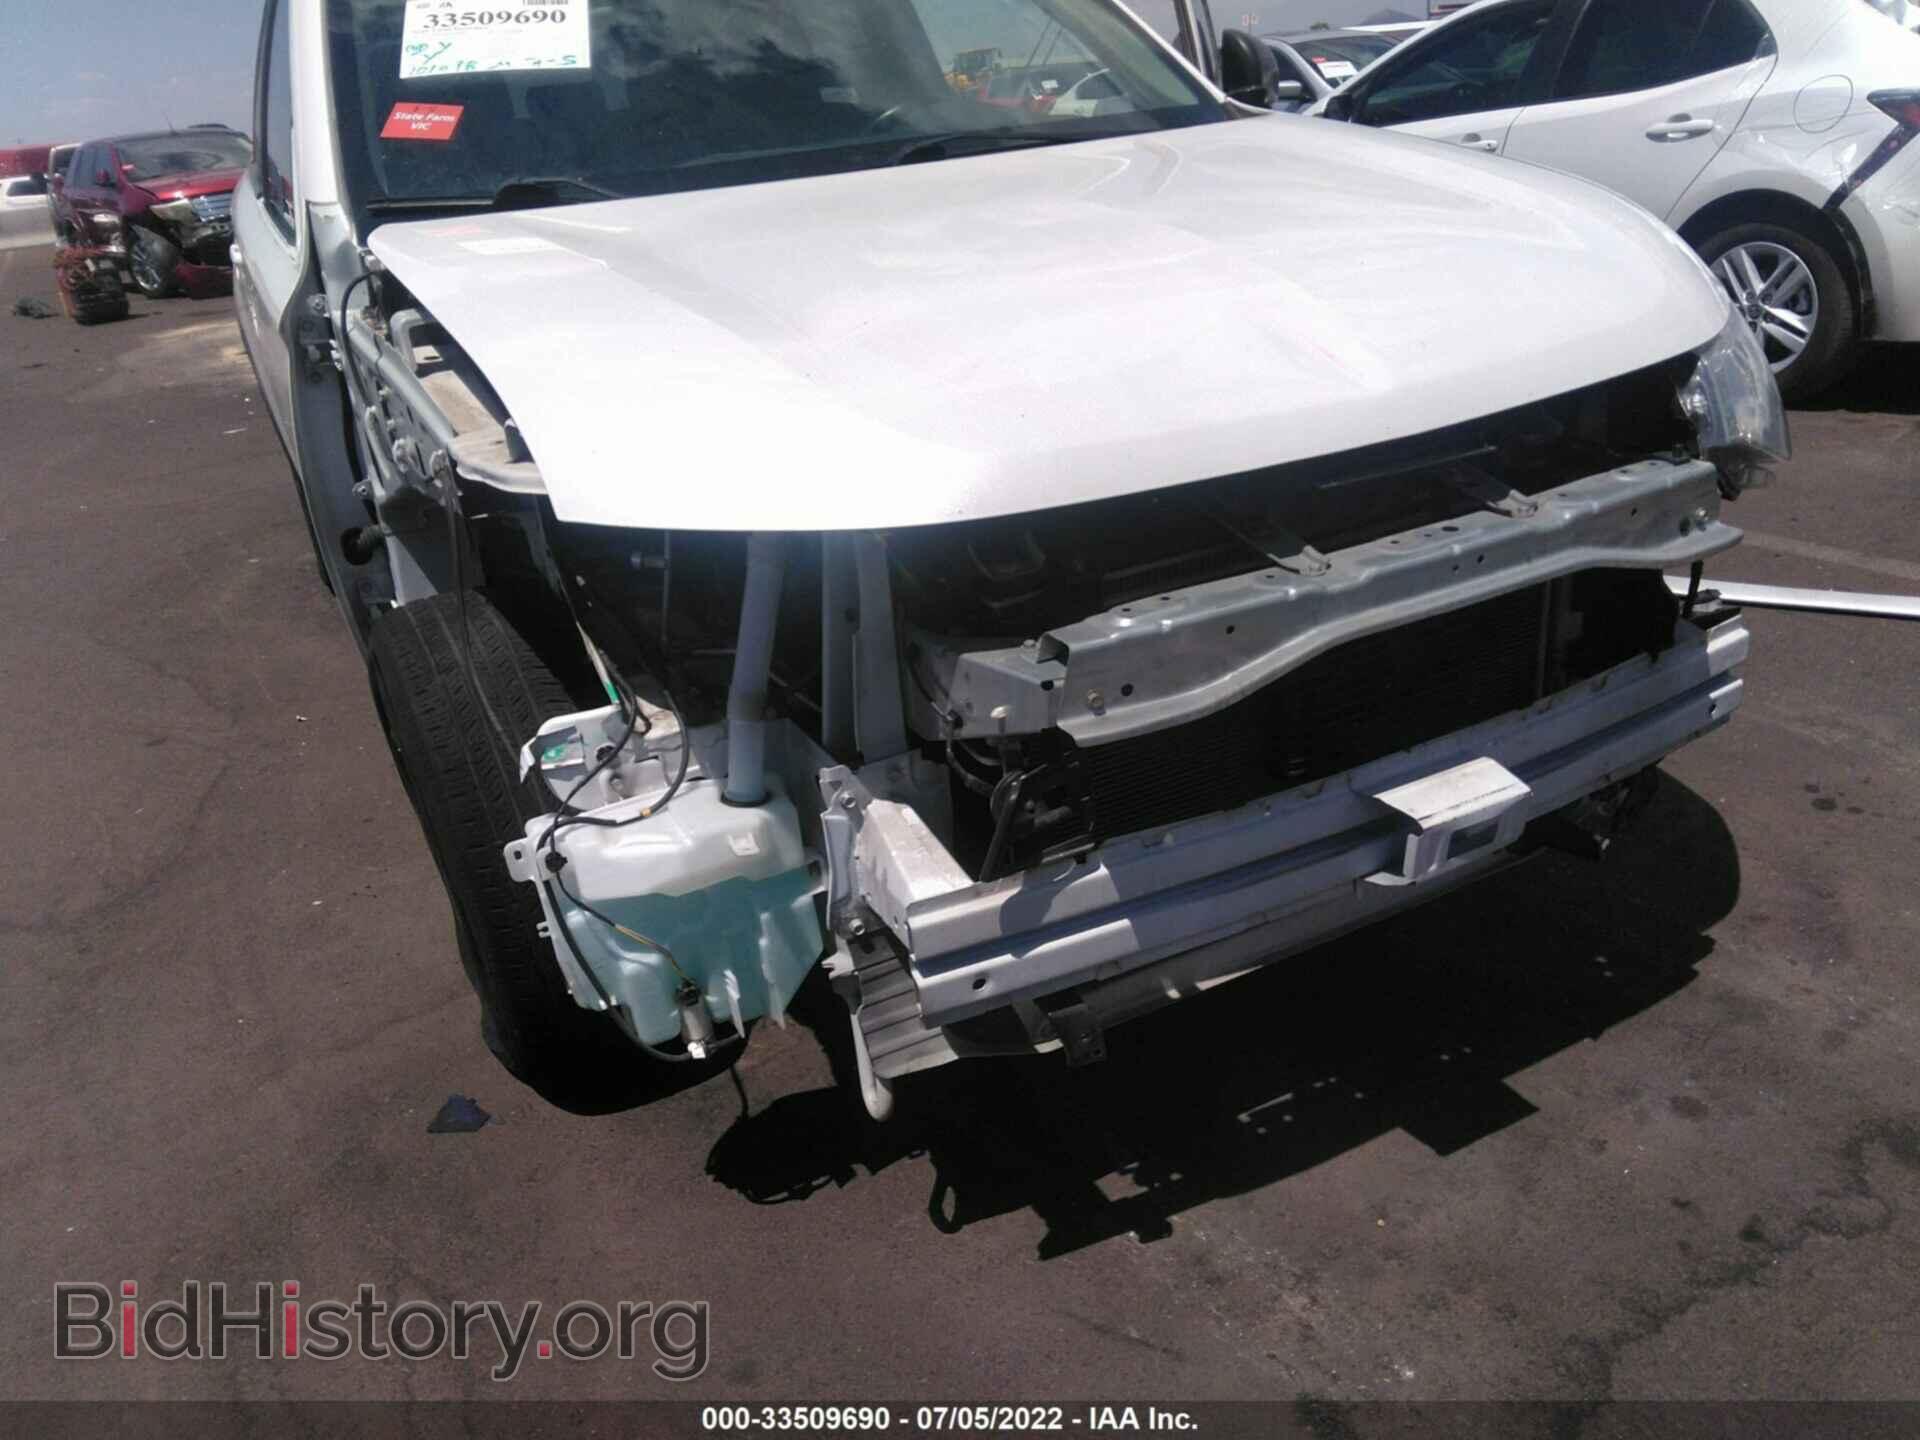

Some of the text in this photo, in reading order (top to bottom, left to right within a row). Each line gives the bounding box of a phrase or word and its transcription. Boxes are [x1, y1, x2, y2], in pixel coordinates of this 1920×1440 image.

[423, 10, 566, 29] 33509690
[393, 112, 455, 121] State Farm
